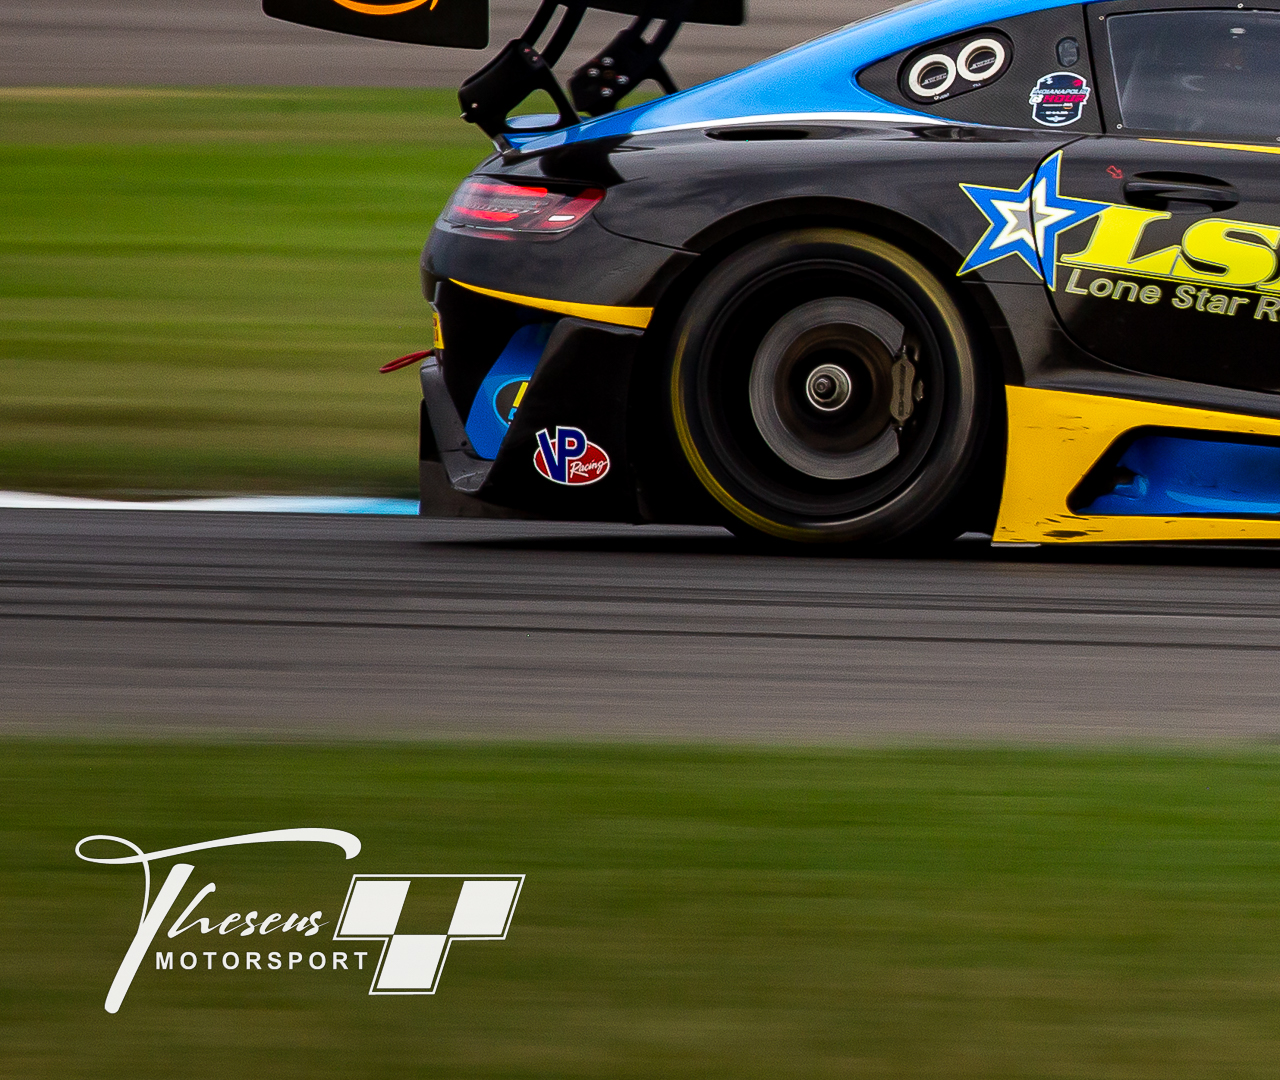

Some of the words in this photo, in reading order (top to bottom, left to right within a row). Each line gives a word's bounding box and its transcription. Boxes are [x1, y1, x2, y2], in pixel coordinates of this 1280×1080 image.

[1043, 95, 1086, 103] HOUR
[1065, 268, 1162, 305] Lone
[1171, 283, 1250, 317] Star
[536, 426, 587, 484] VP
[569, 459, 609, 478] Racing
